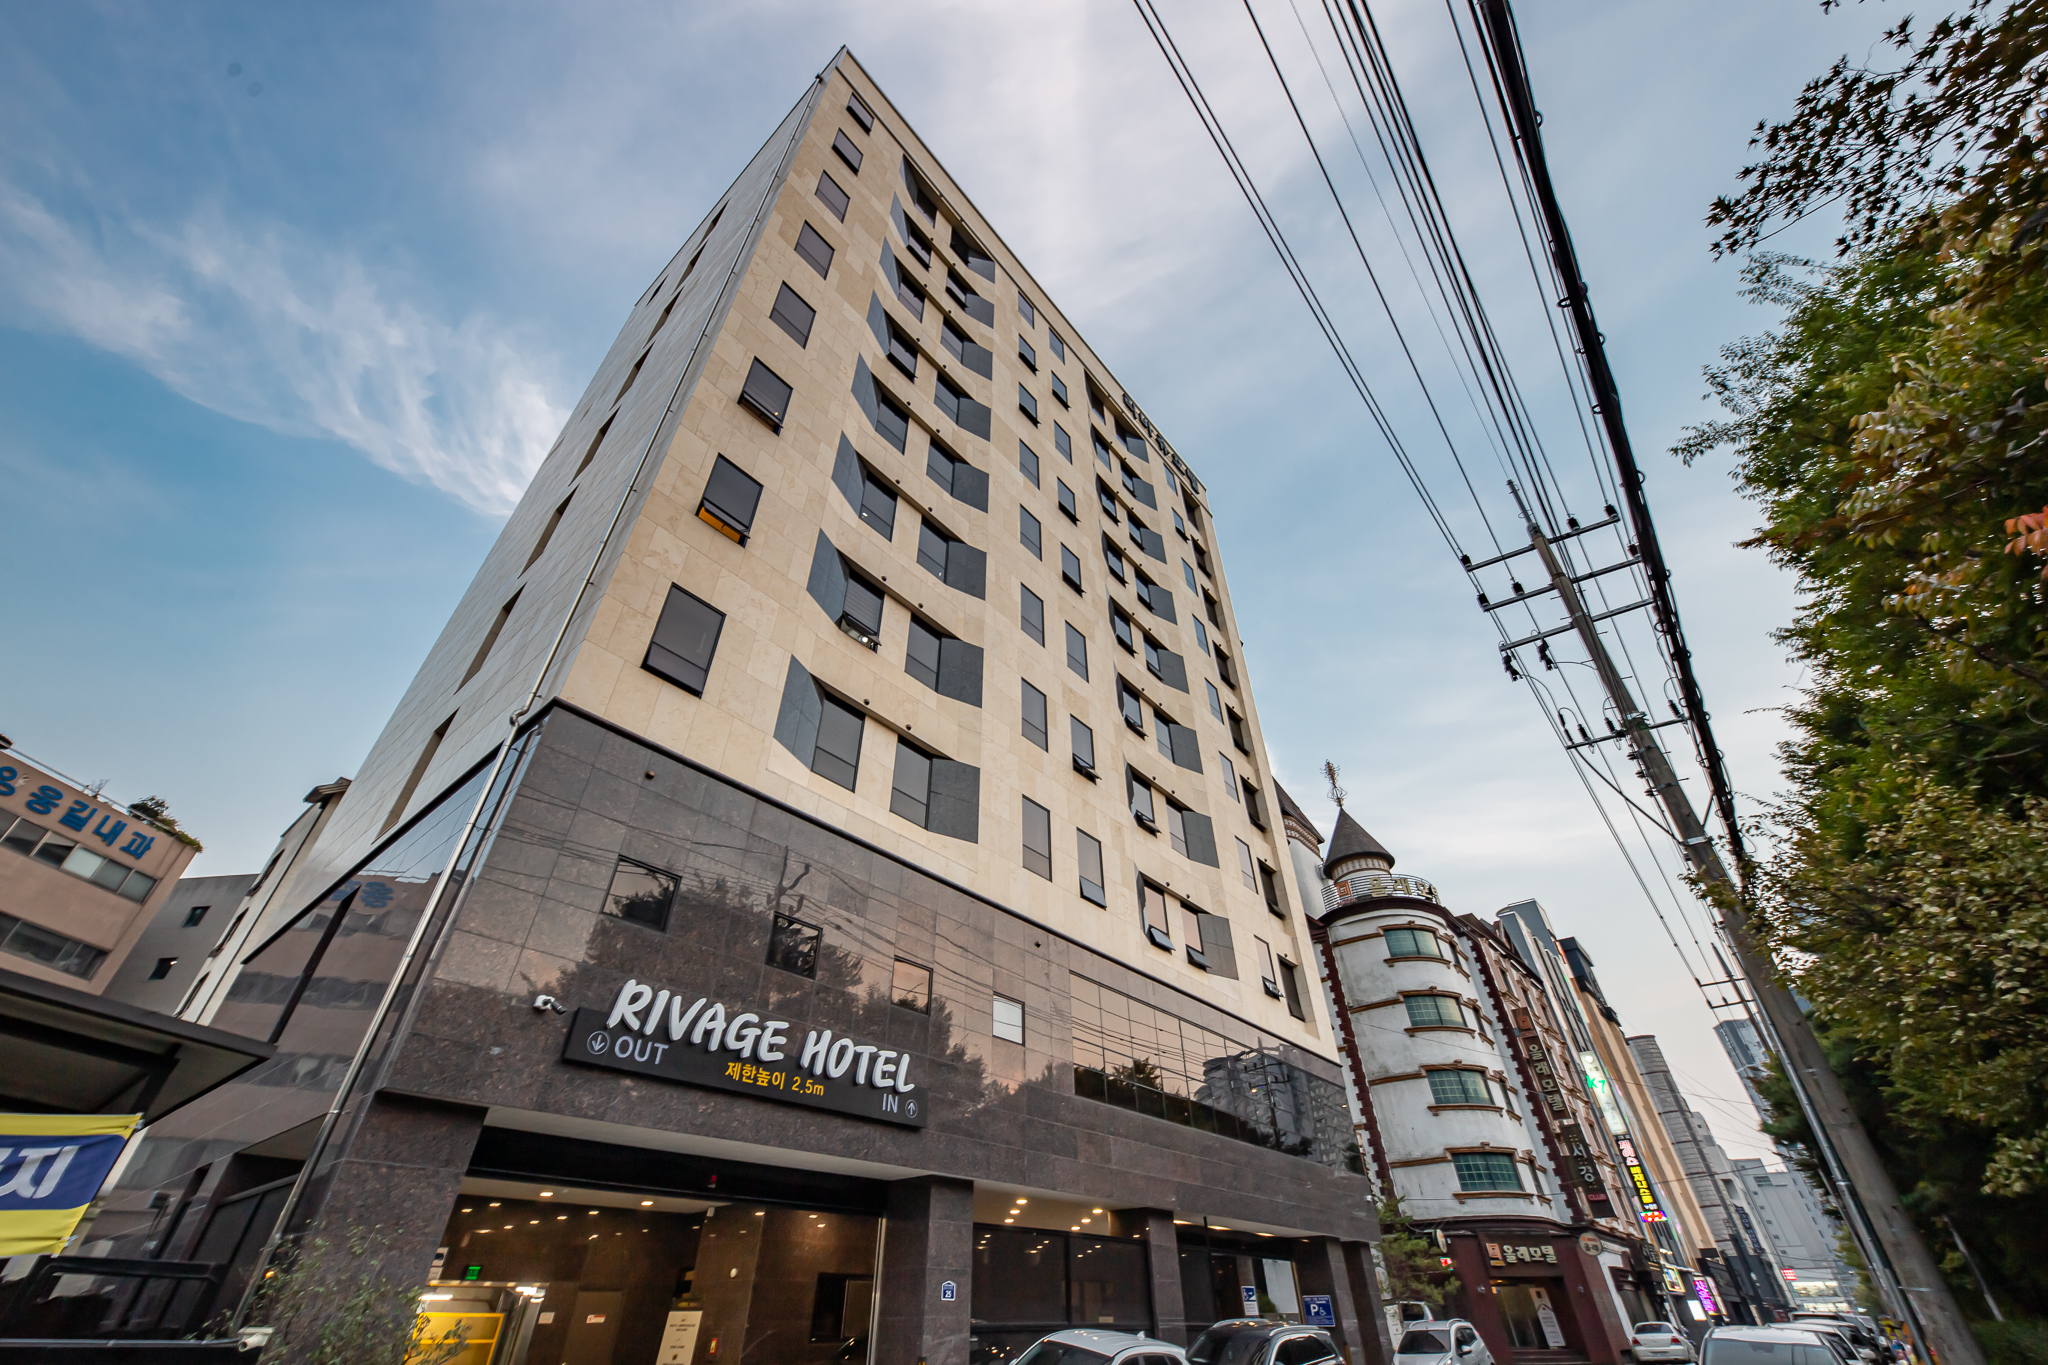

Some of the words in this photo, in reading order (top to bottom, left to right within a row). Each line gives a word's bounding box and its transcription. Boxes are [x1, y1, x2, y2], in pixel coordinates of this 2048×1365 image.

[605, 979, 790, 1062] RIVAGE
[800, 1029, 915, 1093] HOTEL
[614, 1035, 669, 1065] OUT
[724, 1062, 786, 1090] 제한높이
[791, 1076, 824, 1097] 2.5m
[882, 1093, 898, 1113] IN
[1310, 1304, 1319, 1316] P
